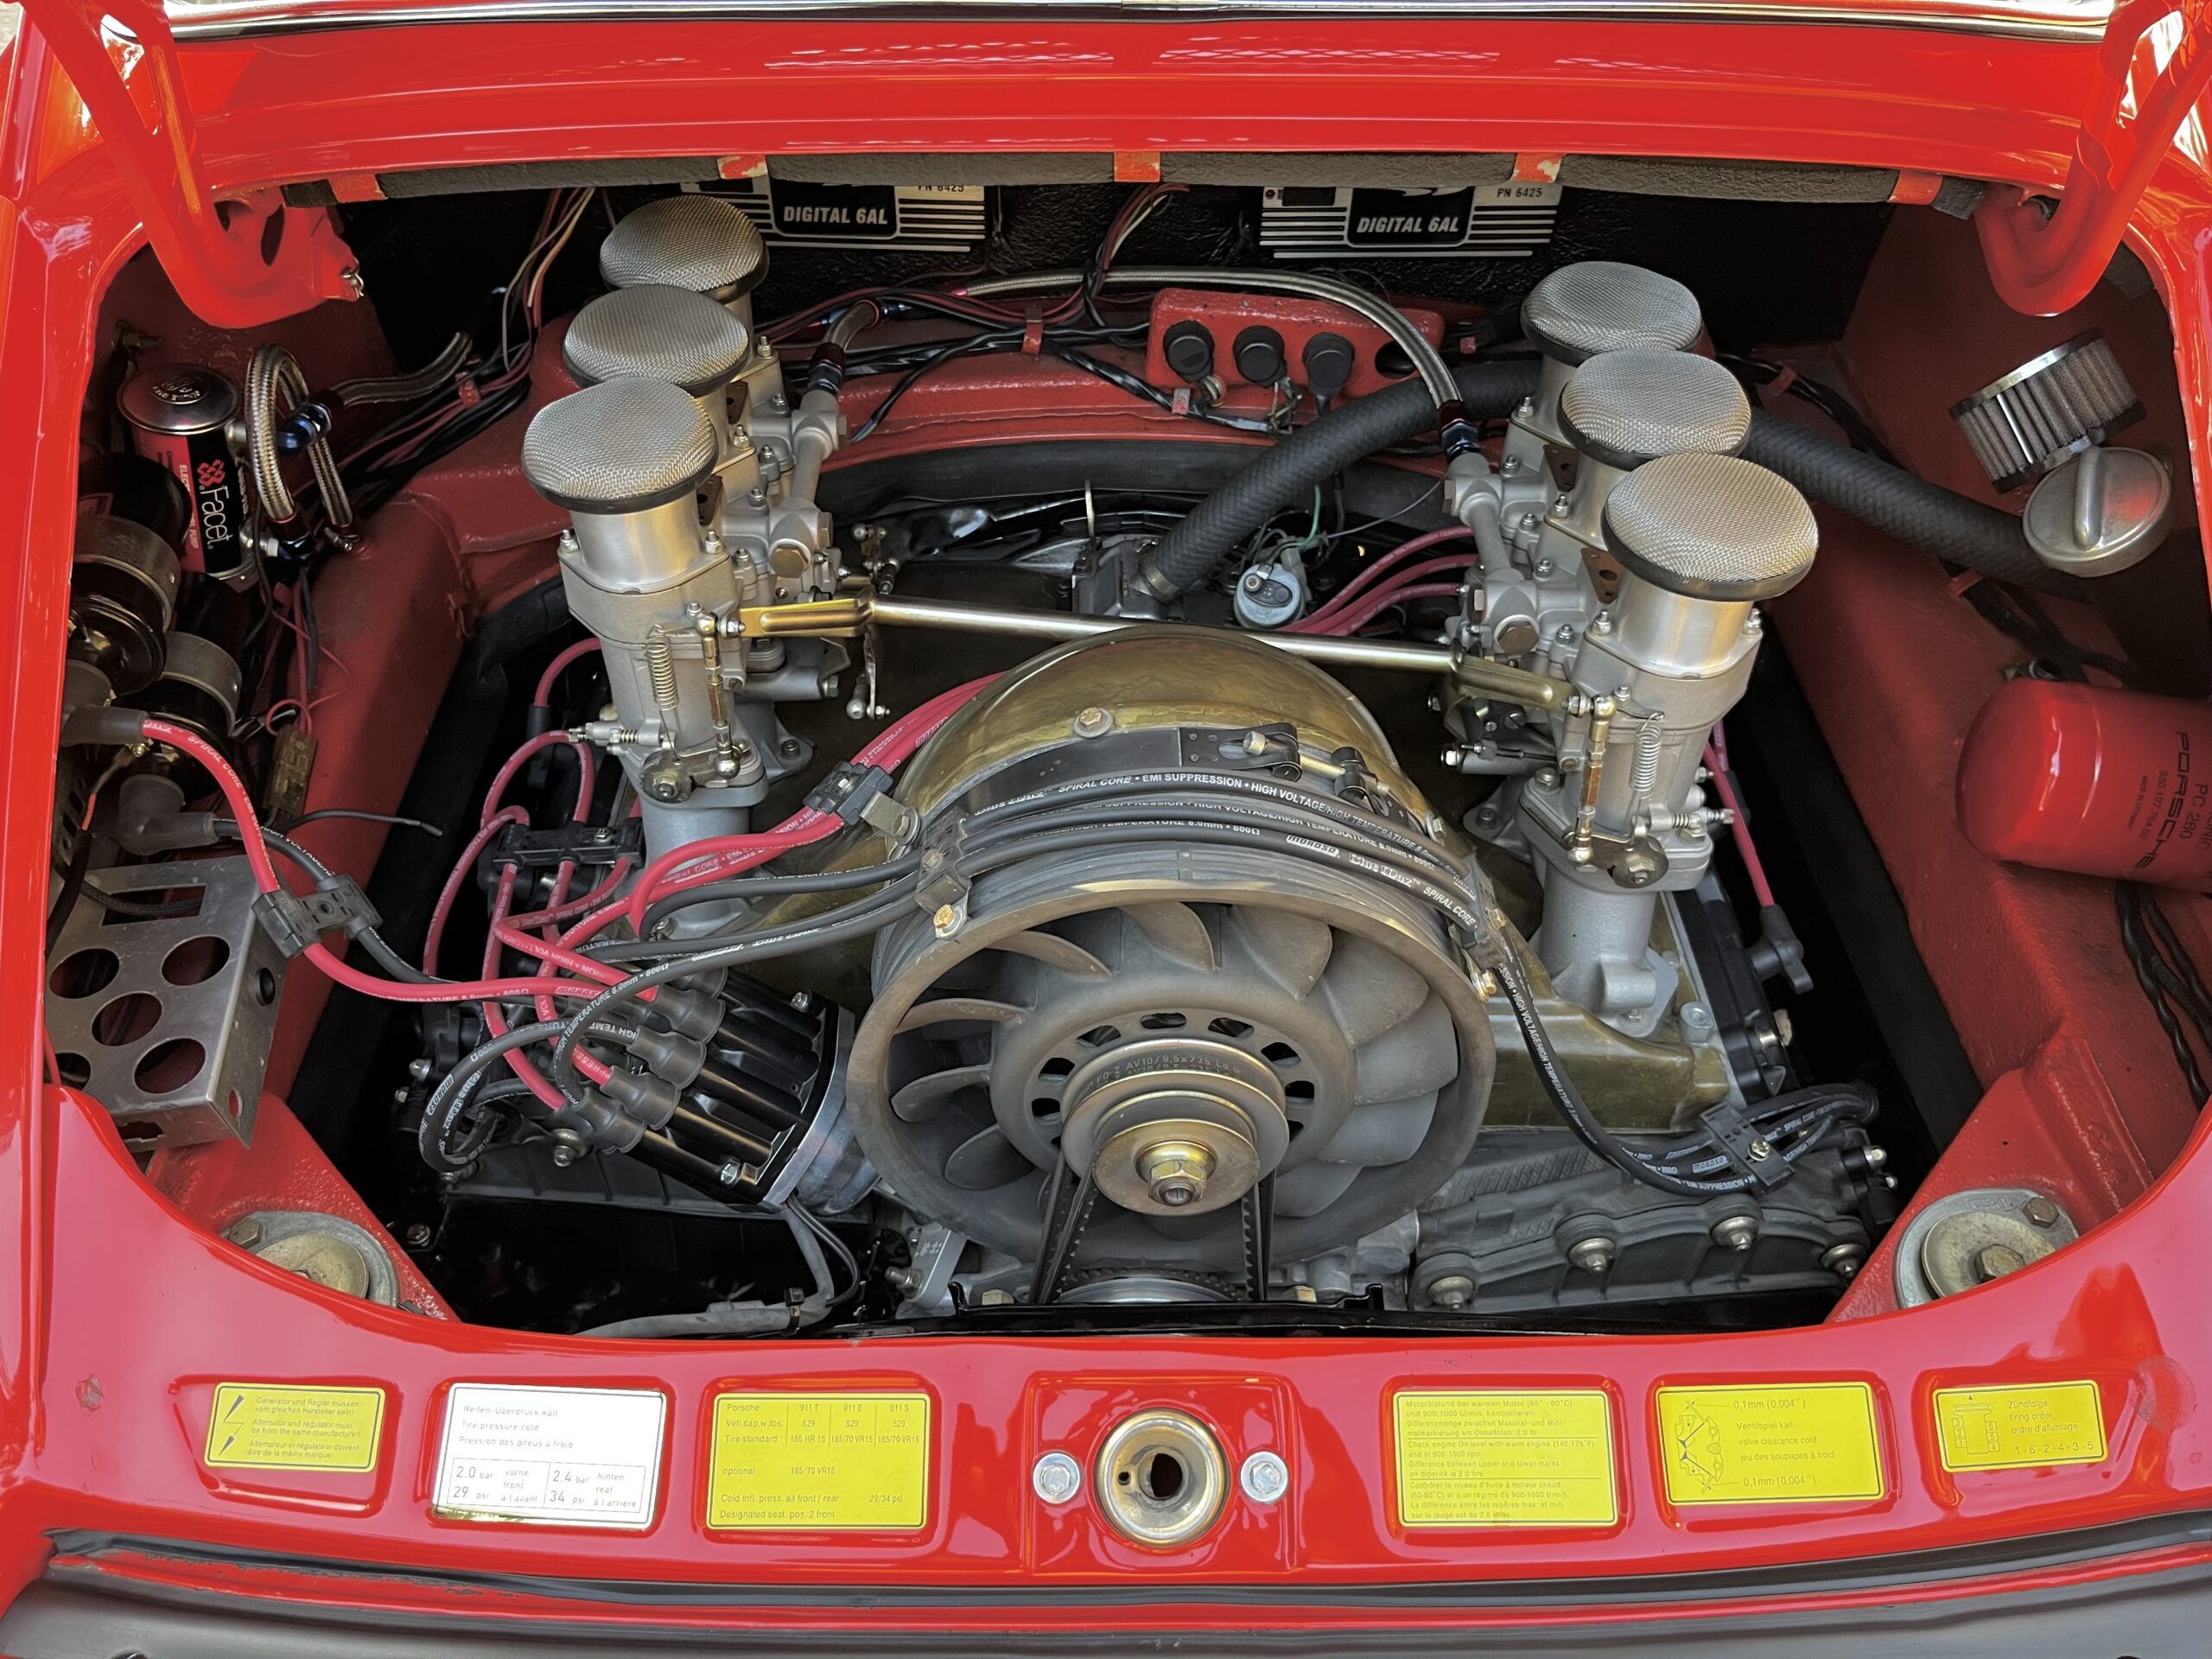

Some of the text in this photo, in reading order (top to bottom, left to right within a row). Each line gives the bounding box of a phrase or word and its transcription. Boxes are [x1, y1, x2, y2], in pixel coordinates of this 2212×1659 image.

[1497, 188, 1542, 199] PN 6425
[783, 207, 888, 225] DIGITAL 6AL
[1356, 217, 1459, 233] DIGITAL 6AL
[200, 485, 233, 544] Facet
[188, 735, 243, 789] SPIRAL CORE
[2134, 731, 2190, 868] PORSCHE
[2190, 783, 2209, 808] PC
[1100, 776, 1132, 786] CORE
[1142, 773, 1162, 782] EMI
[1164, 773, 1243, 789] SUPPRESSION
[1251, 782, 1277, 797] HIGH
[1279, 789, 1351, 821] VOLTAGE/HIGH
[1352, 816, 1416, 850] TEMPERATURE
[1423, 887, 1453, 909] SPIRAL
[1452, 906, 1476, 925] CORE
[564, 992, 612, 1039] TEMPERATURE
[612, 976, 639, 995] 8.0mm
[1512, 993, 1527, 1013] HIGH
[257, 1397, 290, 1406] Generator
[307, 1399, 330, 1408] Regler
[727, 1403, 910, 1413] Porsche 911 911 911 S
[2008, 1400, 2048, 1409] Zündfolge
[271, 1406, 301, 1414] gleichen
[803, 1419, 816, 1427] 529
[893, 1420, 906, 1428] 529
[2009, 1414, 2029, 1422] firing
[462, 1420, 539, 1433] Tire pressure cold
[2012, 1425, 2032, 1433] ordre
[249, 1440, 287, 1449] Alternateur
[459, 1435, 574, 1449] Pression des pneus froid
[831, 1435, 854, 1444] 185/70
[878, 1435, 900, 1444] 185/70
[1740, 1453, 1752, 1462] jeu
[1771, 1452, 1808, 1462] soupapes
[455, 1465, 476, 1478] 2.0
[480, 1471, 493, 1480] bar
[553, 1470, 625, 1484] 2.4 bar hinten
[722, 1467, 755, 1477] optional
[503, 1481, 524, 1490] front
[595, 1485, 613, 1494] rear
[453, 1486, 489, 1501] 29 psi
[550, 1491, 586, 1505] 34 psi
[721, 1494, 741, 1503] Cold
[742, 1494, 757, 1503] infl.
[760, 1496, 782, 1506] press.
[786, 1494, 795, 1503] all
[798, 1494, 816, 1503] front
[892, 1495, 903, 1505] psi
[720, 1510, 766, 1520] Designated
[790, 1512, 807, 1521] pos.
[817, 1510, 835, 1519] front
